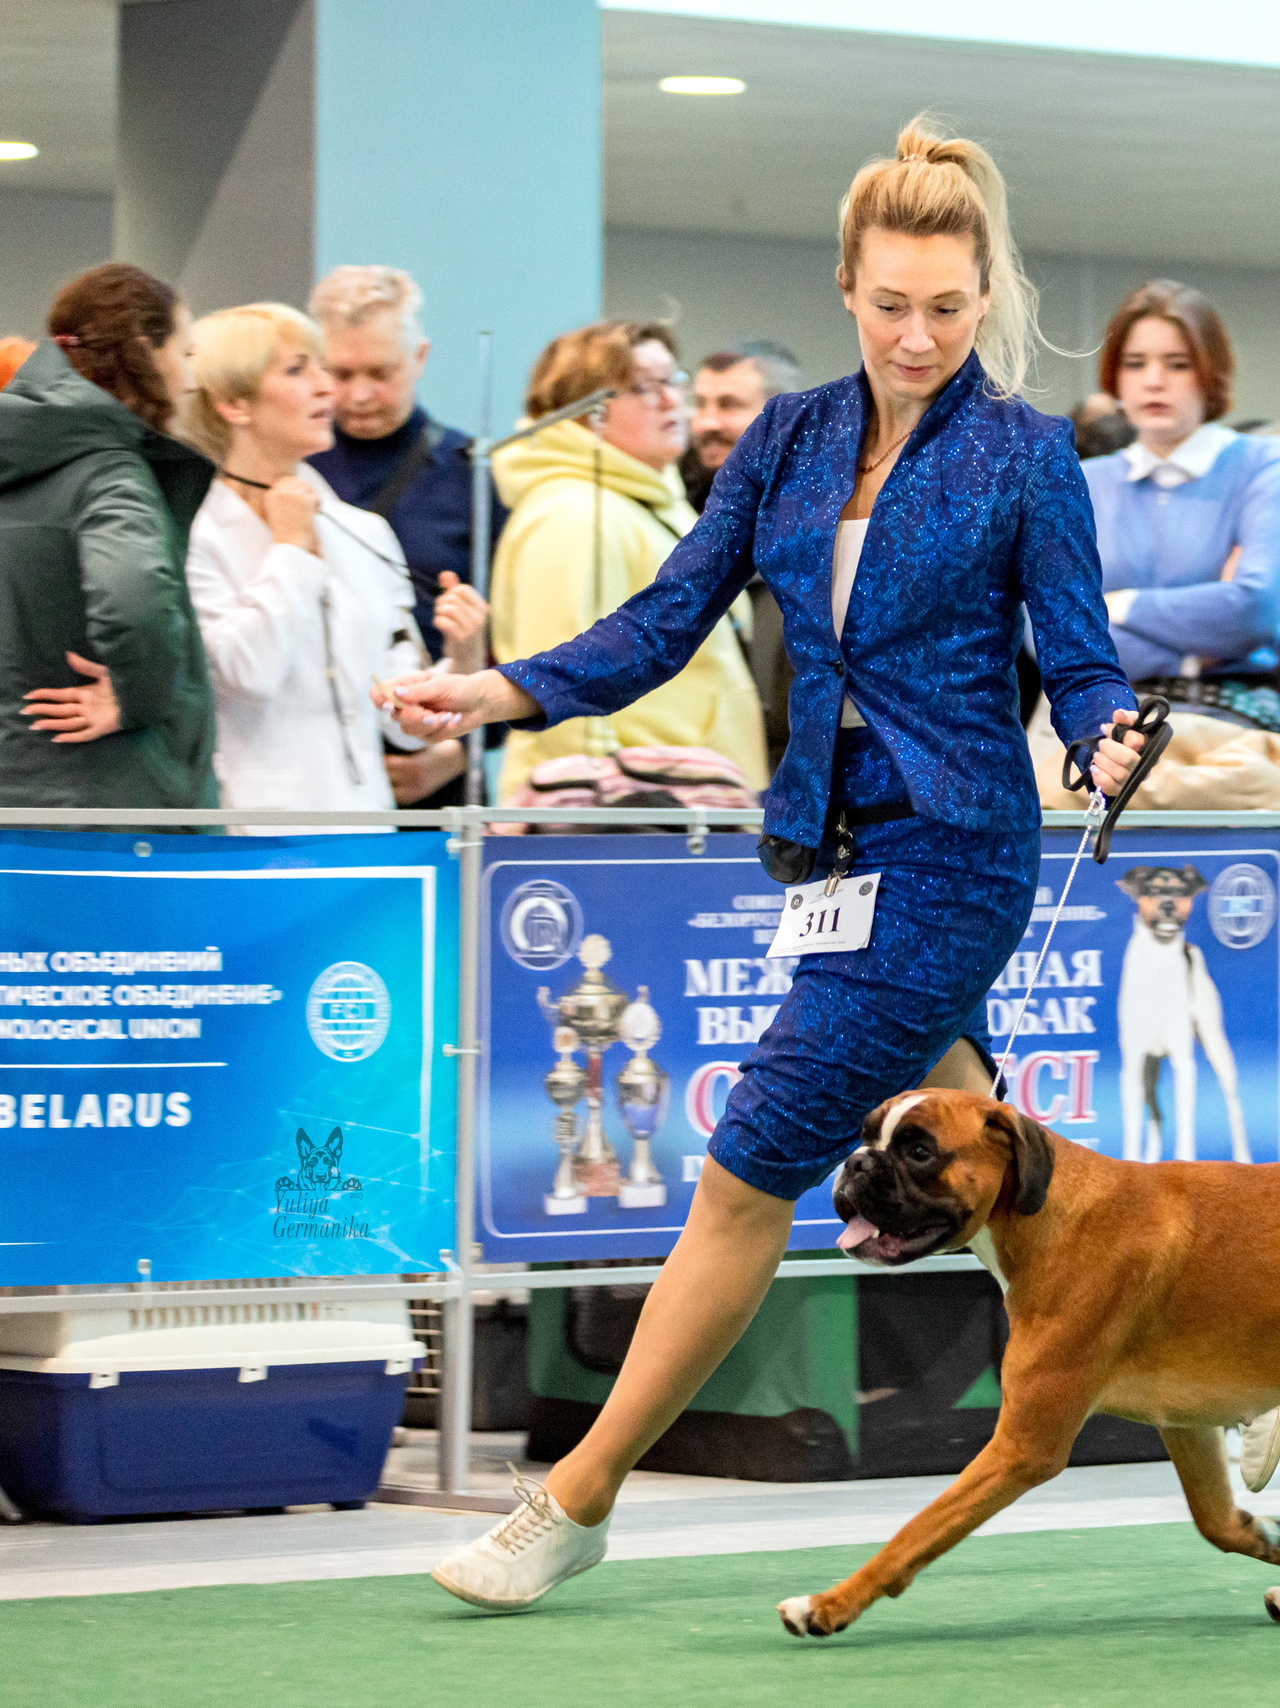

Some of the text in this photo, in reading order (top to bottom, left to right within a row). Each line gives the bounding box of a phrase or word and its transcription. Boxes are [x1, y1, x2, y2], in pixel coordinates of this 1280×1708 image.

[798, 906, 841, 938] 311
[128, 1018, 202, 1039] UNION
[0, 1092, 192, 1128] BELARUS
